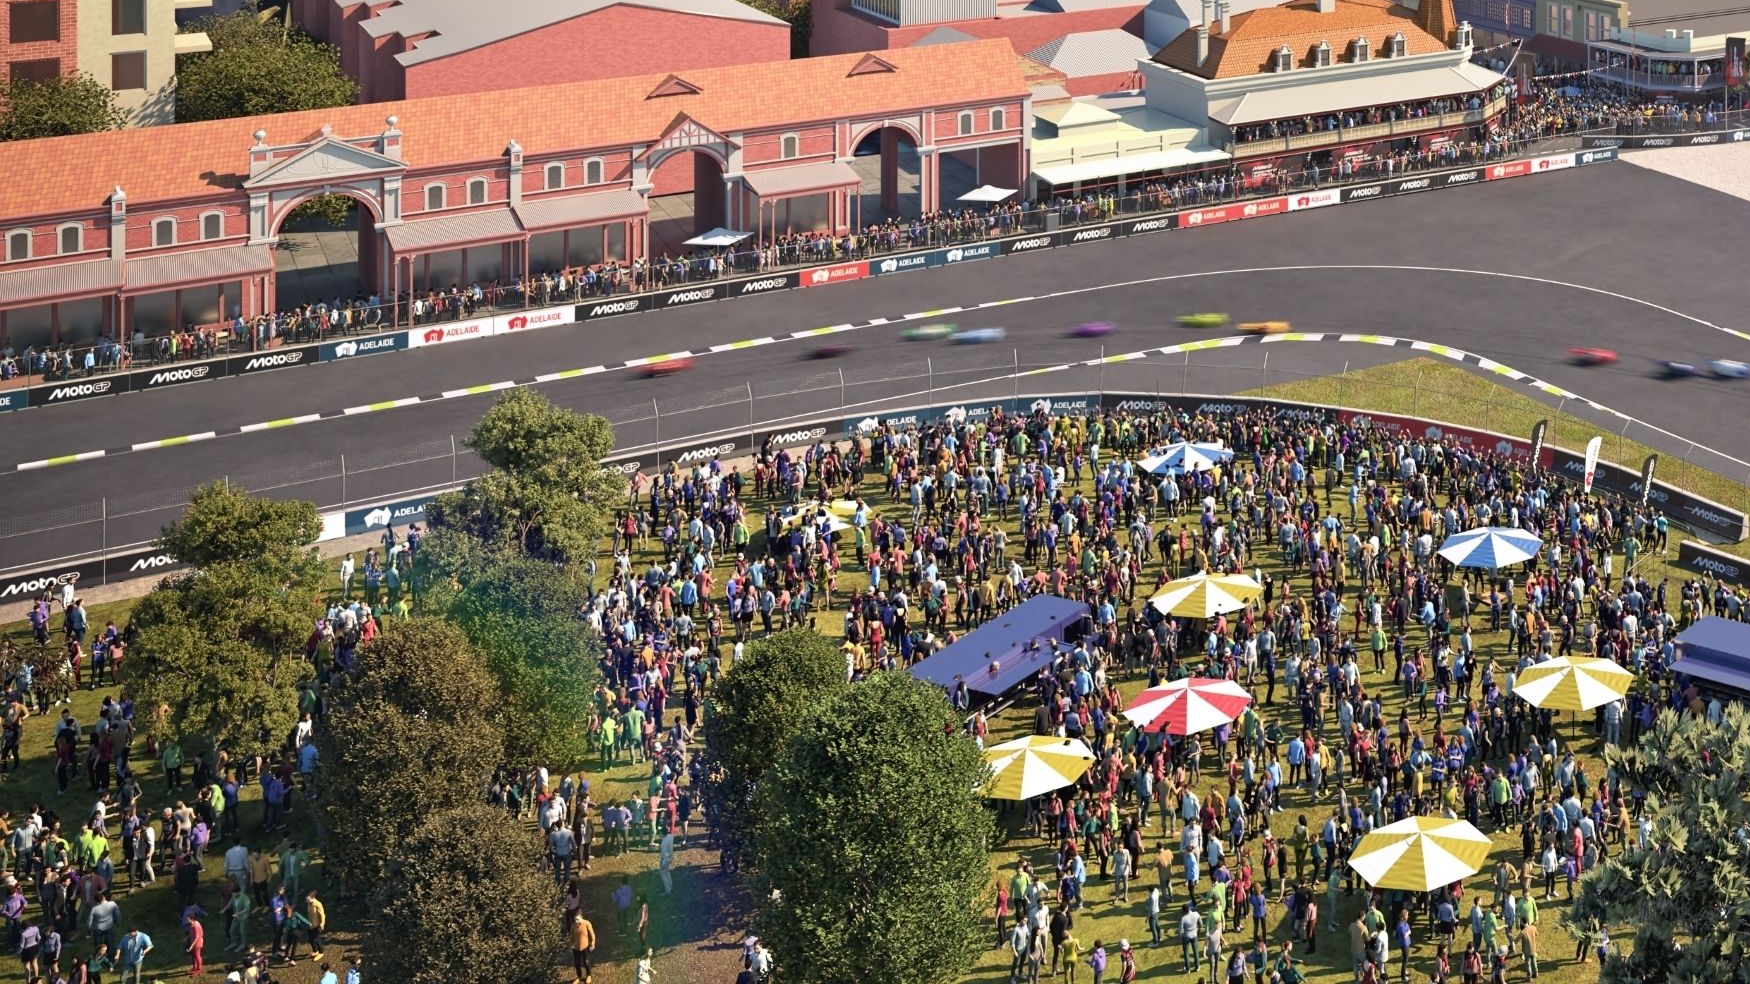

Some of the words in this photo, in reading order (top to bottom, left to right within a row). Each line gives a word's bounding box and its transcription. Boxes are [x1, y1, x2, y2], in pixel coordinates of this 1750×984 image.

[1133, 219, 1168, 232] MotoGP
[1073, 227, 1111, 241] MotoGP
[1012, 237, 1051, 251] MotoGP
[964, 247, 990, 257] ADELAIDE
[898, 256, 926, 267] ADELAIDE
[830, 267, 859, 277] ADELAIDE
[742, 277, 787, 293] MotoGP
[667, 288, 715, 304] MotoGP
[590, 300, 638, 316] MotoGP
[529, 312, 562, 324] ADELAIDE
[446, 324, 480, 337] ADELAIDE
[358, 337, 395, 351] ADELAIDE
[245, 351, 303, 370] MotoGP
[149, 366, 209, 385] MotoGP
[49, 381, 111, 400] MotoGP
[886, 416, 917, 426] DELAIDE
[772, 427, 826, 444] MotoGP
[678, 443, 735, 463] MotoGP
[394, 504, 426, 518] ADELA
[130, 554, 178, 572] Mot
[1692, 556, 1739, 577] MotoGP
